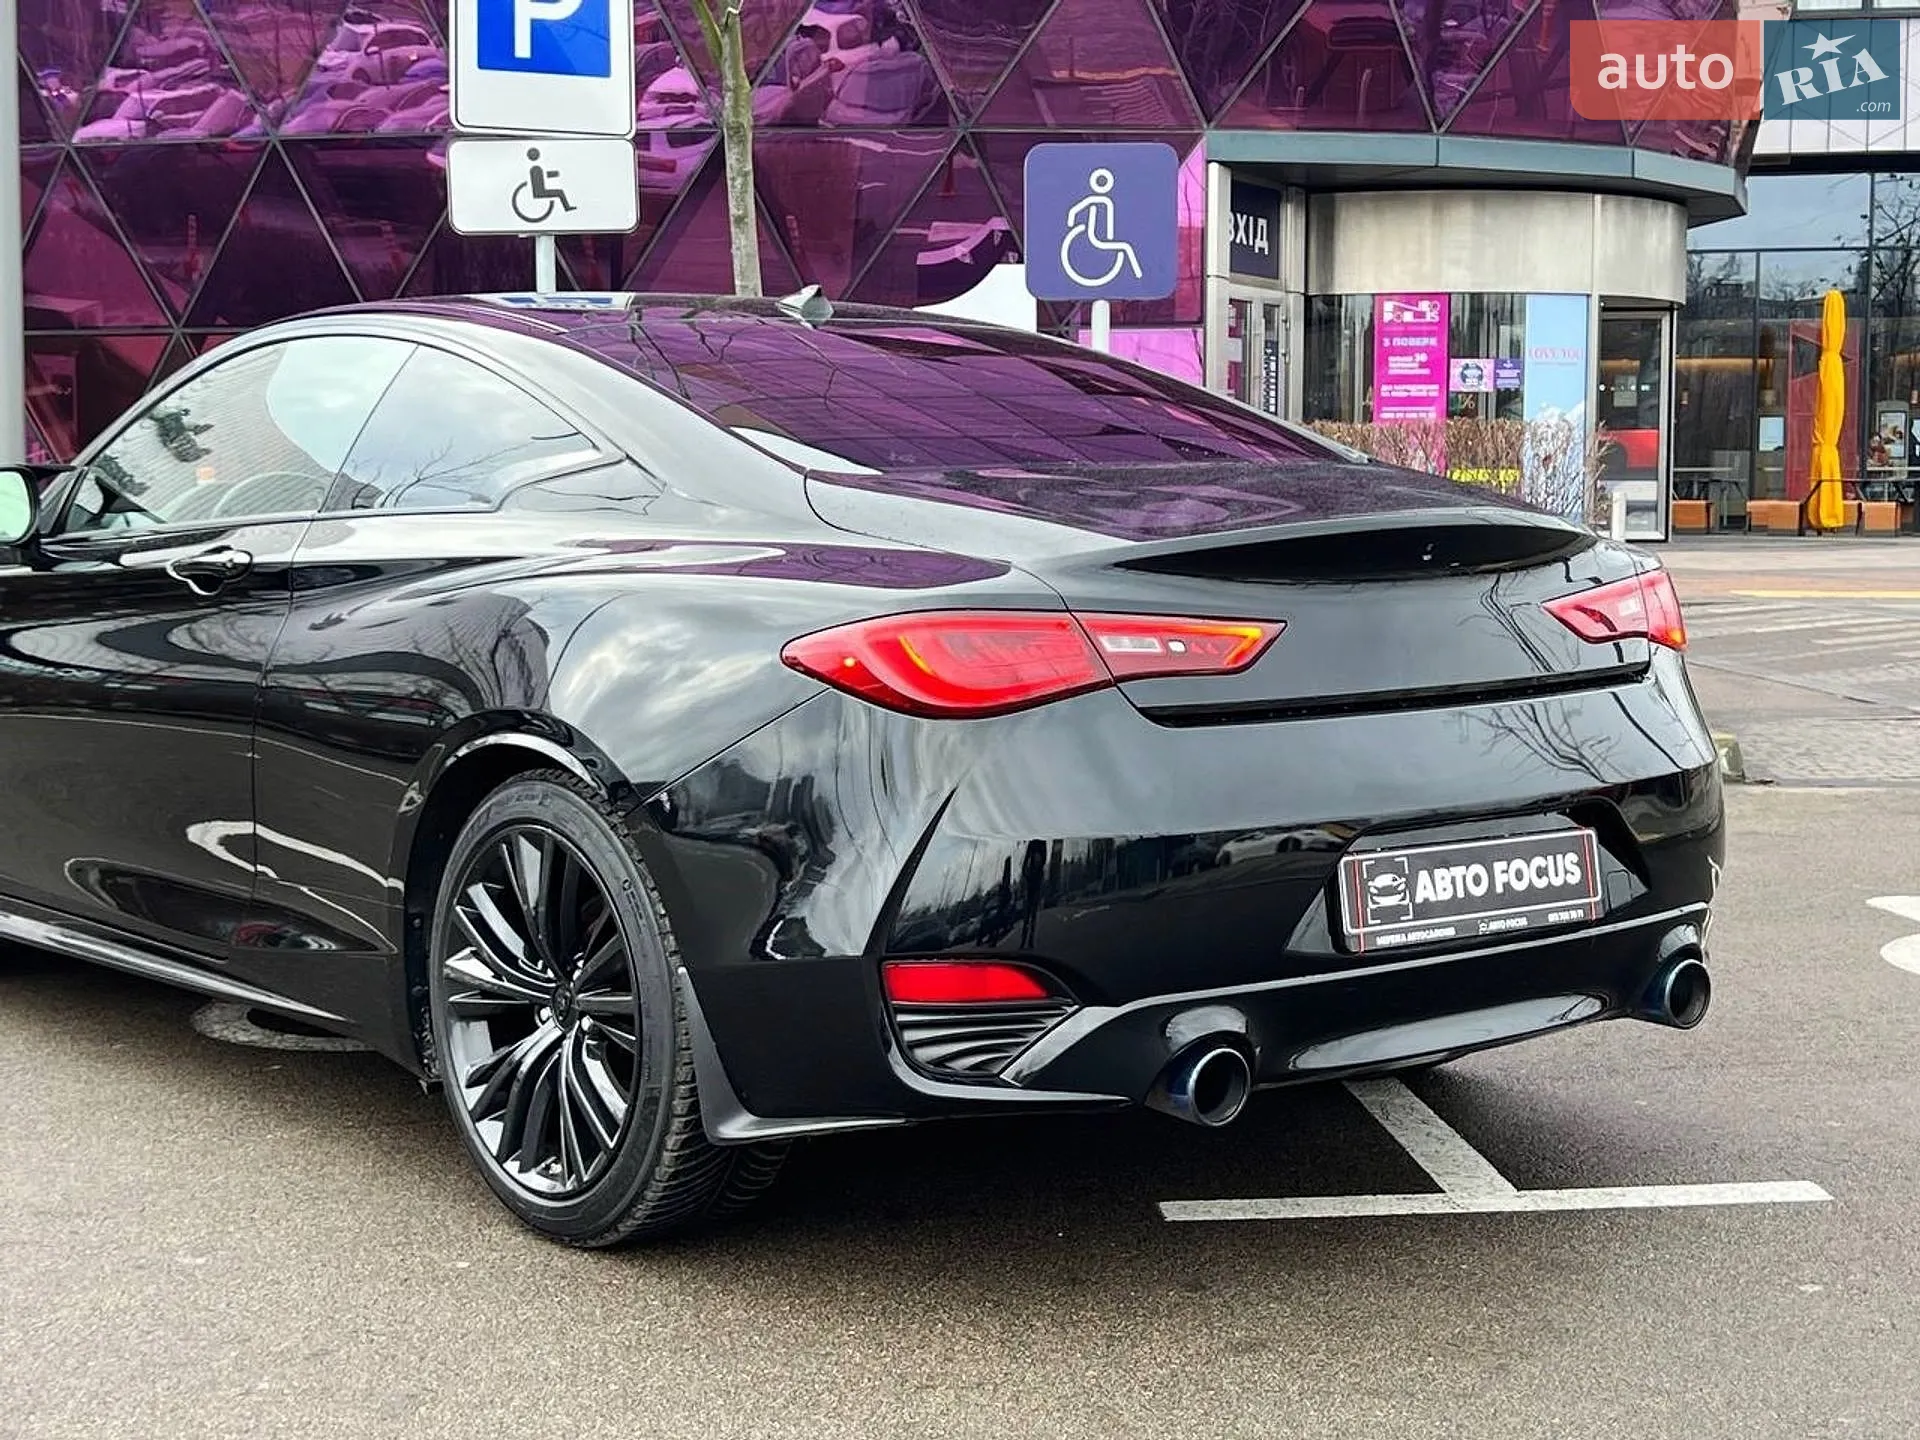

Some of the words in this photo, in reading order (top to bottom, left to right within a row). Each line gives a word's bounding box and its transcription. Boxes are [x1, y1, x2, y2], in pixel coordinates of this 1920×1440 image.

[514, 0, 585, 59] P
[1414, 863, 1489, 904] АВТО
[1493, 851, 1582, 894] FOCUS
